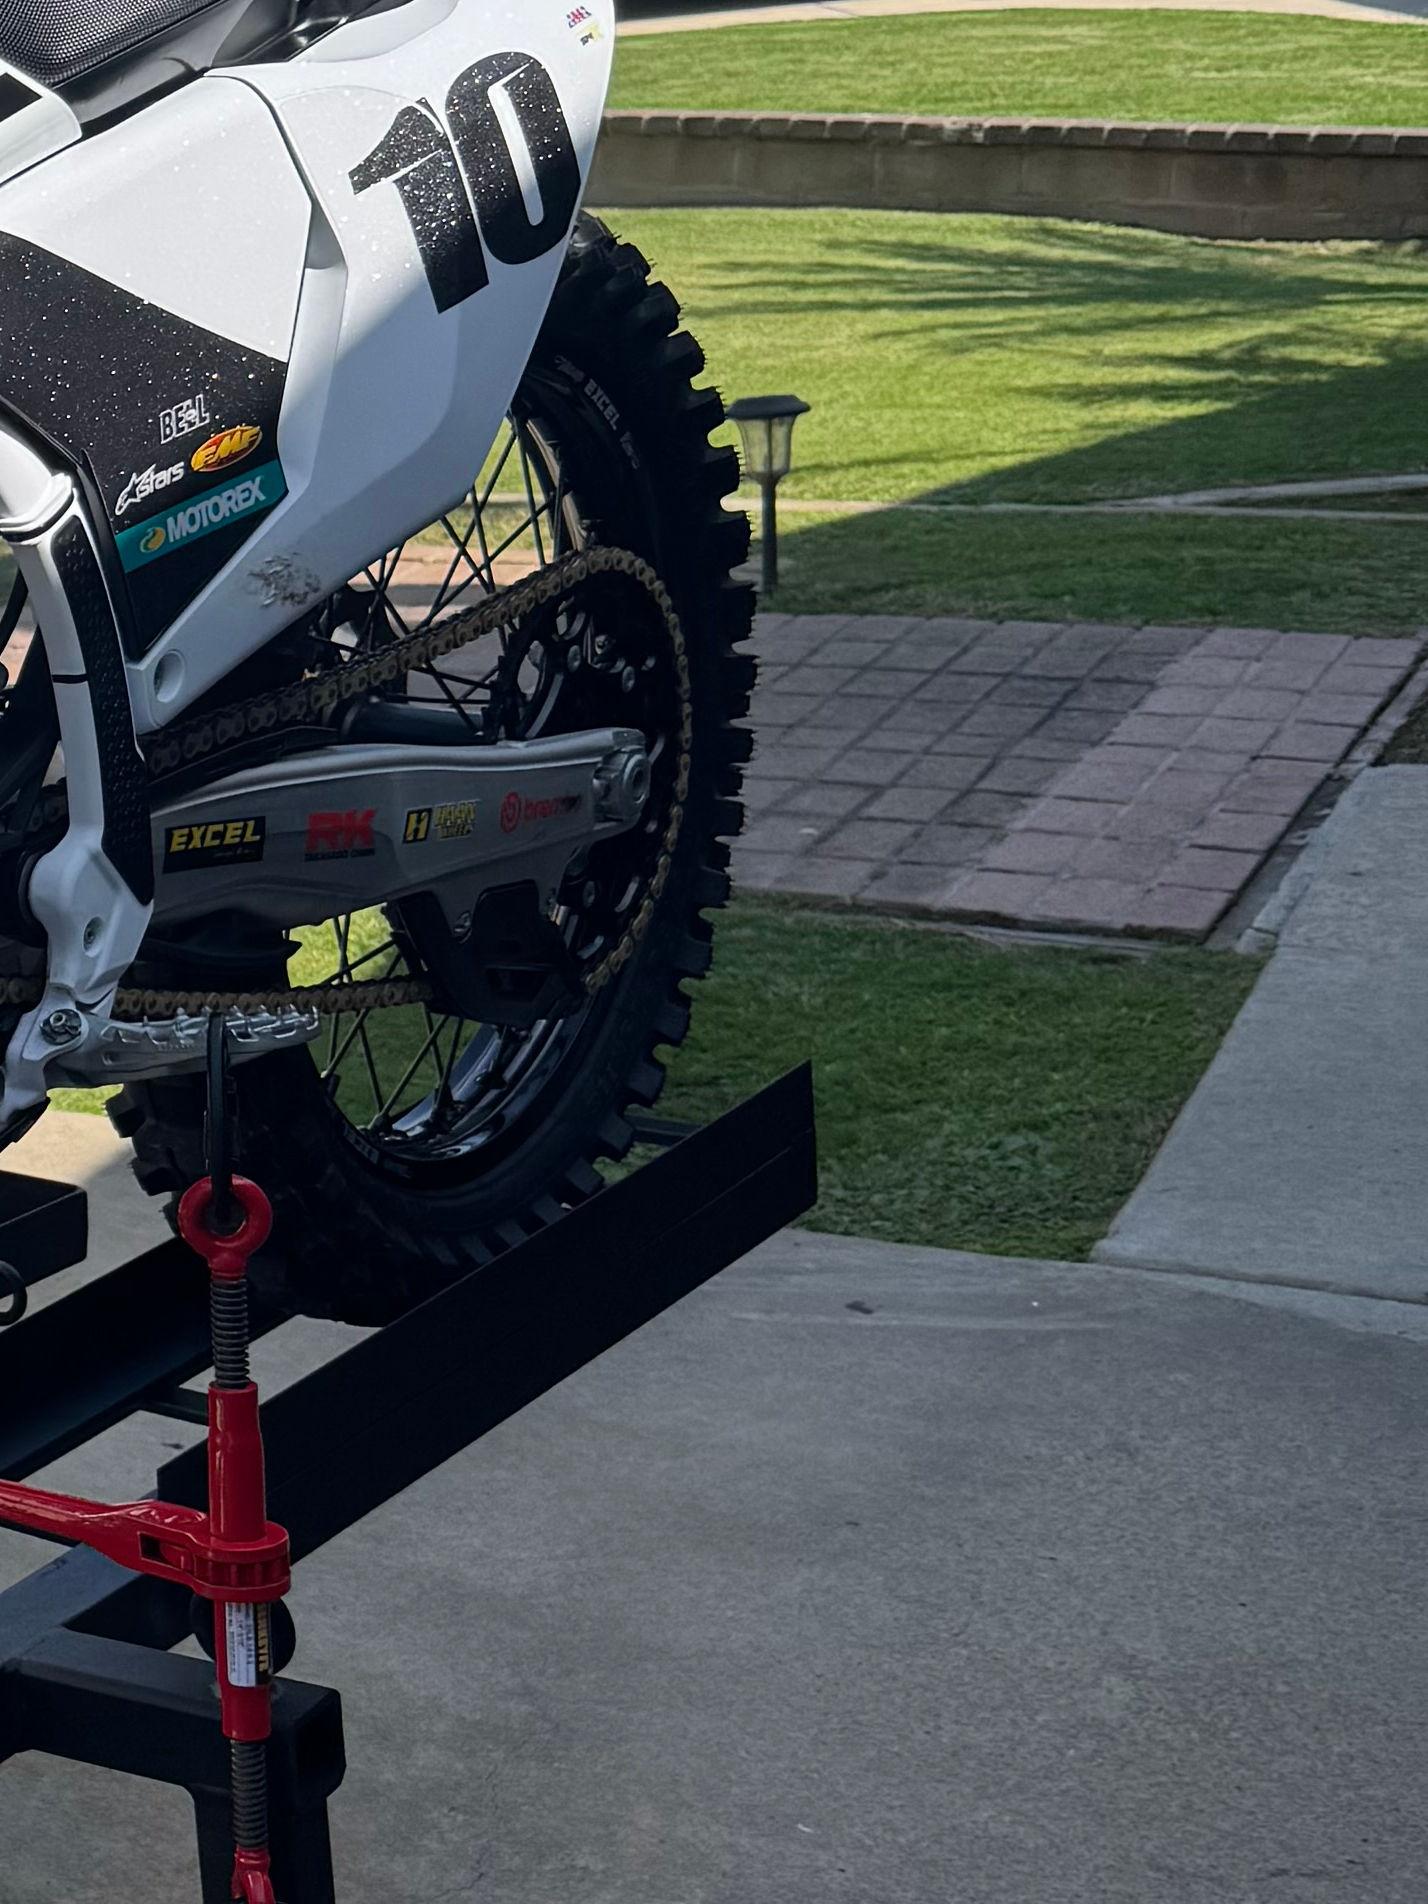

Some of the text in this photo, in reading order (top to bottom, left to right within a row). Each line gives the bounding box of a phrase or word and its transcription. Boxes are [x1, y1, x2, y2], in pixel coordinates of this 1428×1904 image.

[348, 50, 581, 316] 10
[166, 476, 266, 543] MOTOREX
[170, 819, 262, 854] EXCEL
[305, 809, 379, 853] RK
